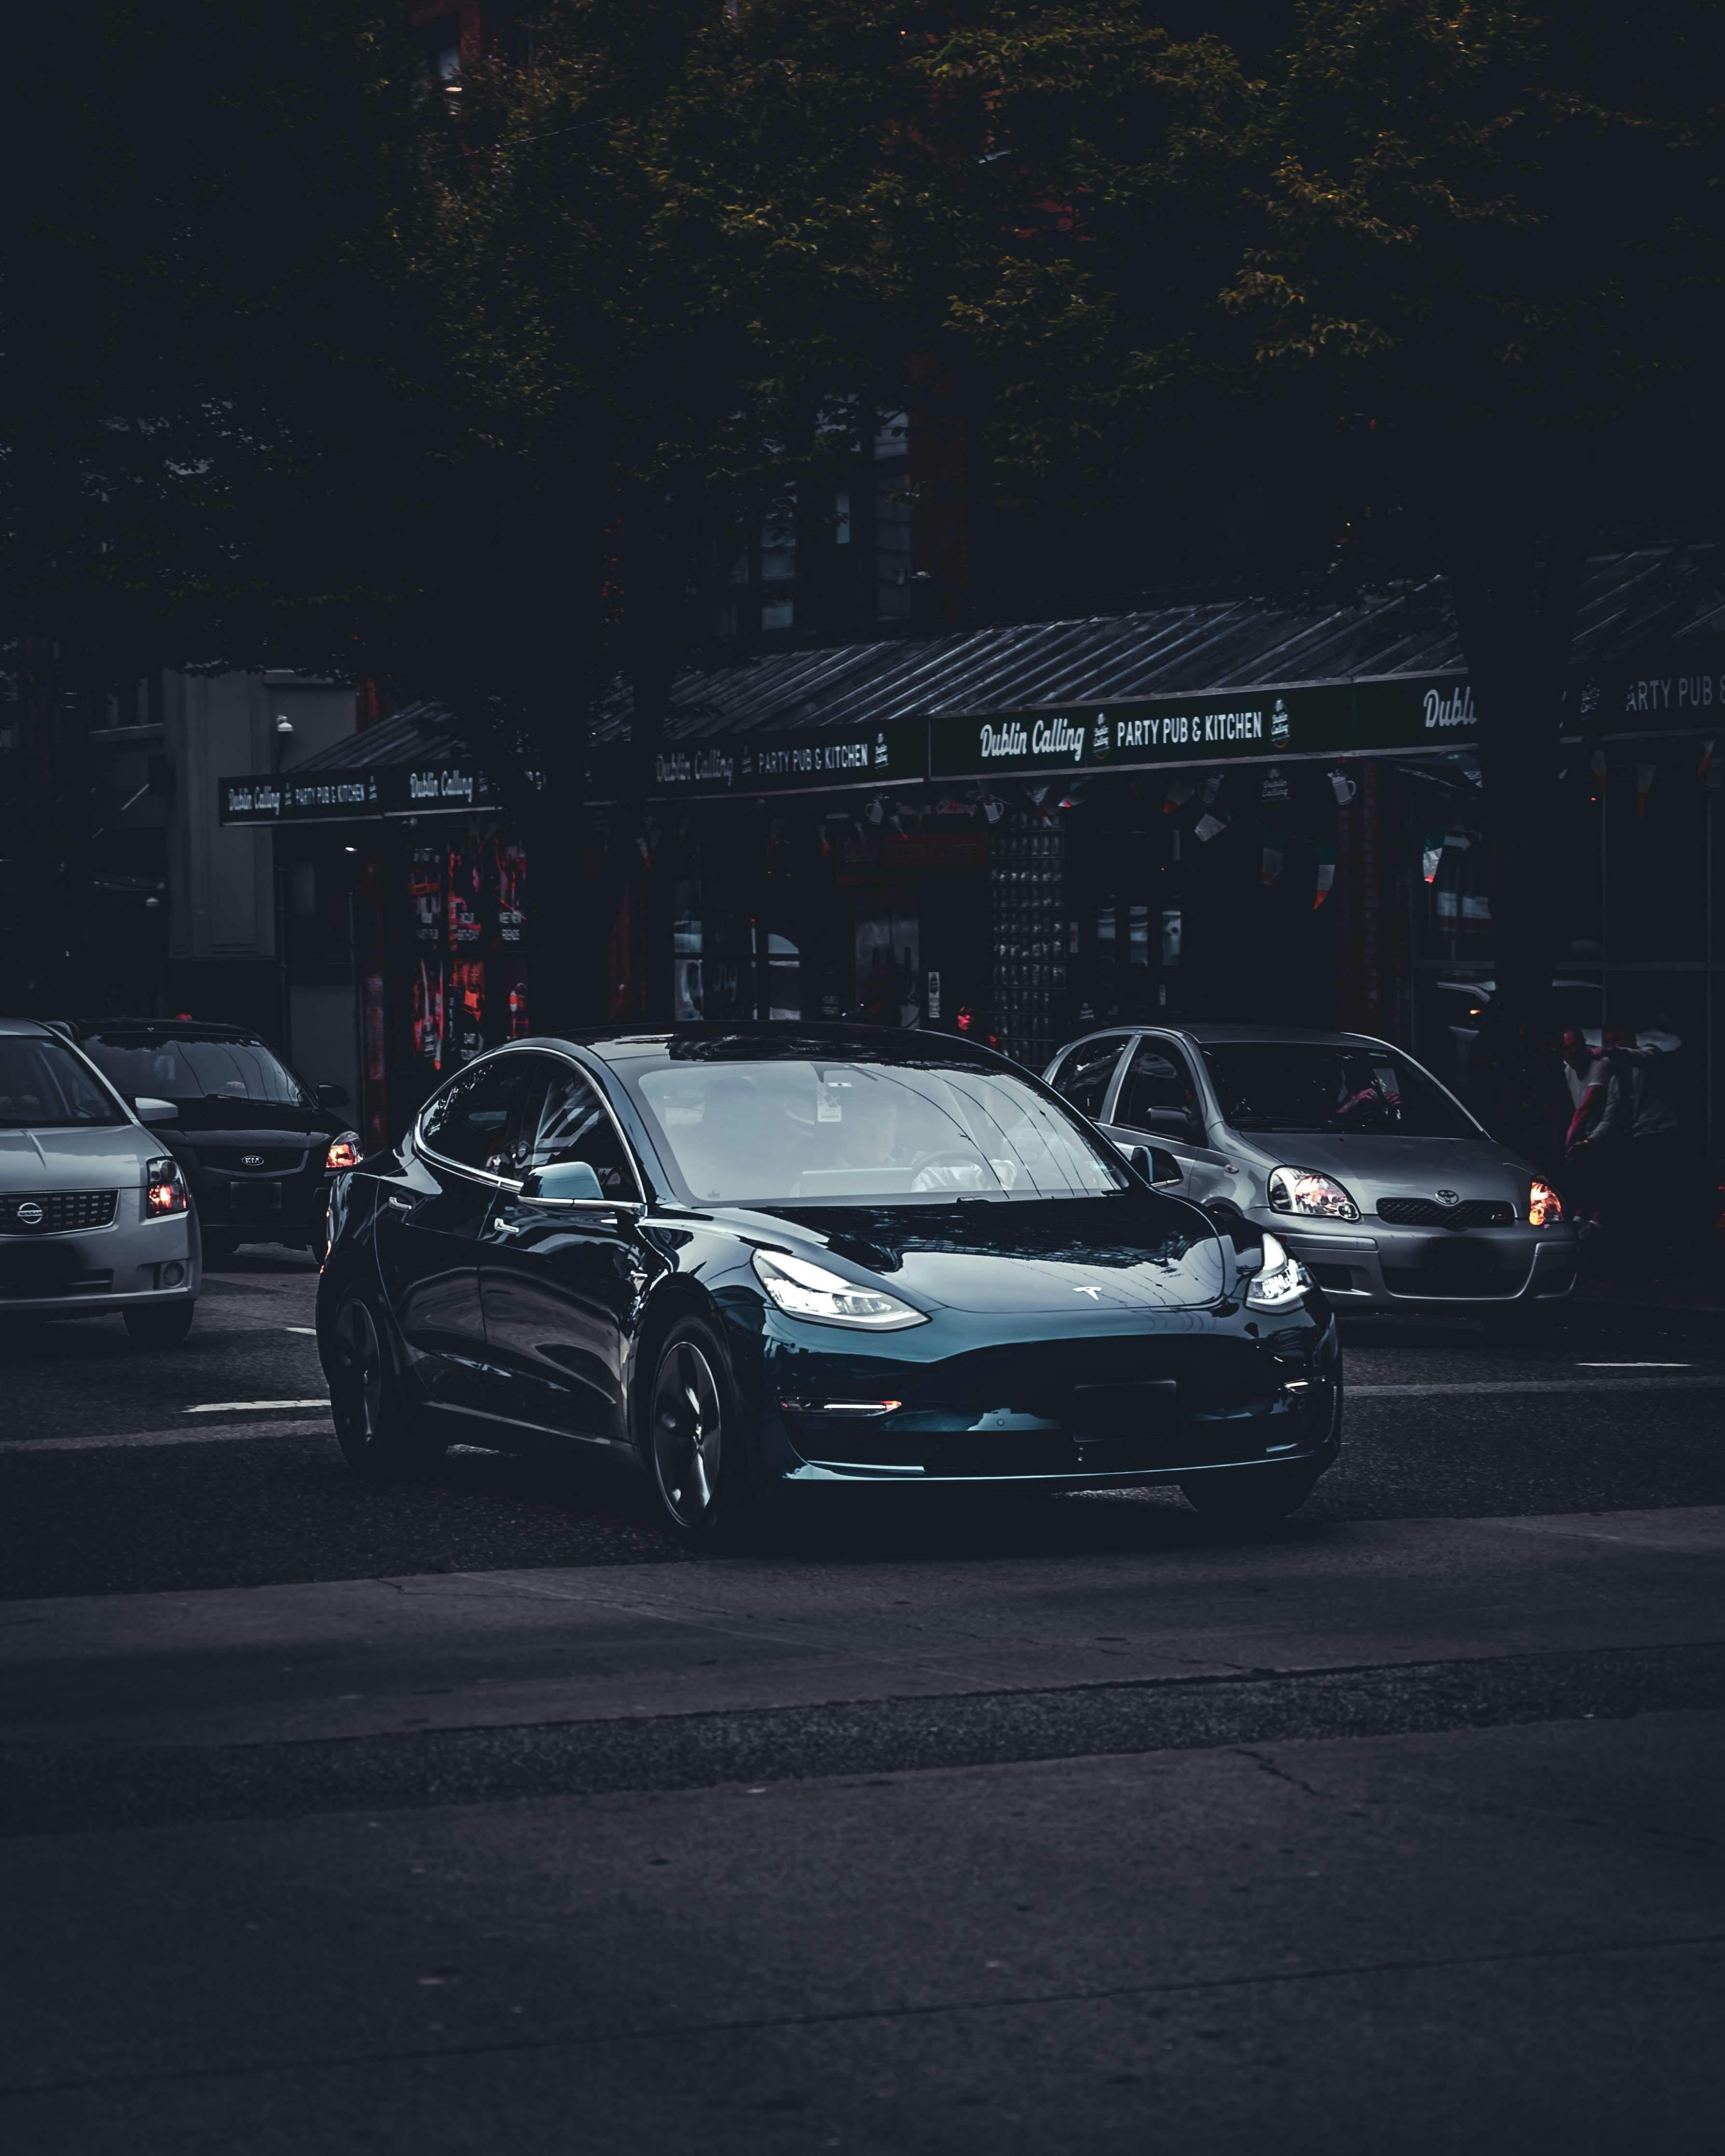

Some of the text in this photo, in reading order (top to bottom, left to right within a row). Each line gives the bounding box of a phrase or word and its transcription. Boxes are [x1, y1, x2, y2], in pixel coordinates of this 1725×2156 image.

[1624, 679, 1671, 711] ARTY
[1678, 675, 1712, 707] PUB
[980, 718, 1085, 761] Dublin Calling
[1117, 711, 1262, 747] PARTY PUB & KITCHEN
[656, 753, 691, 783] Dublin
[694, 749, 733, 786] Calling
[758, 750, 789, 774] PARTY
[793, 749, 812, 771] PUB
[815, 748, 822, 770] &
[824, 744, 868, 769] KITCHEN
[410, 772, 438, 798] Dublin
[441, 770, 473, 803] Calling
